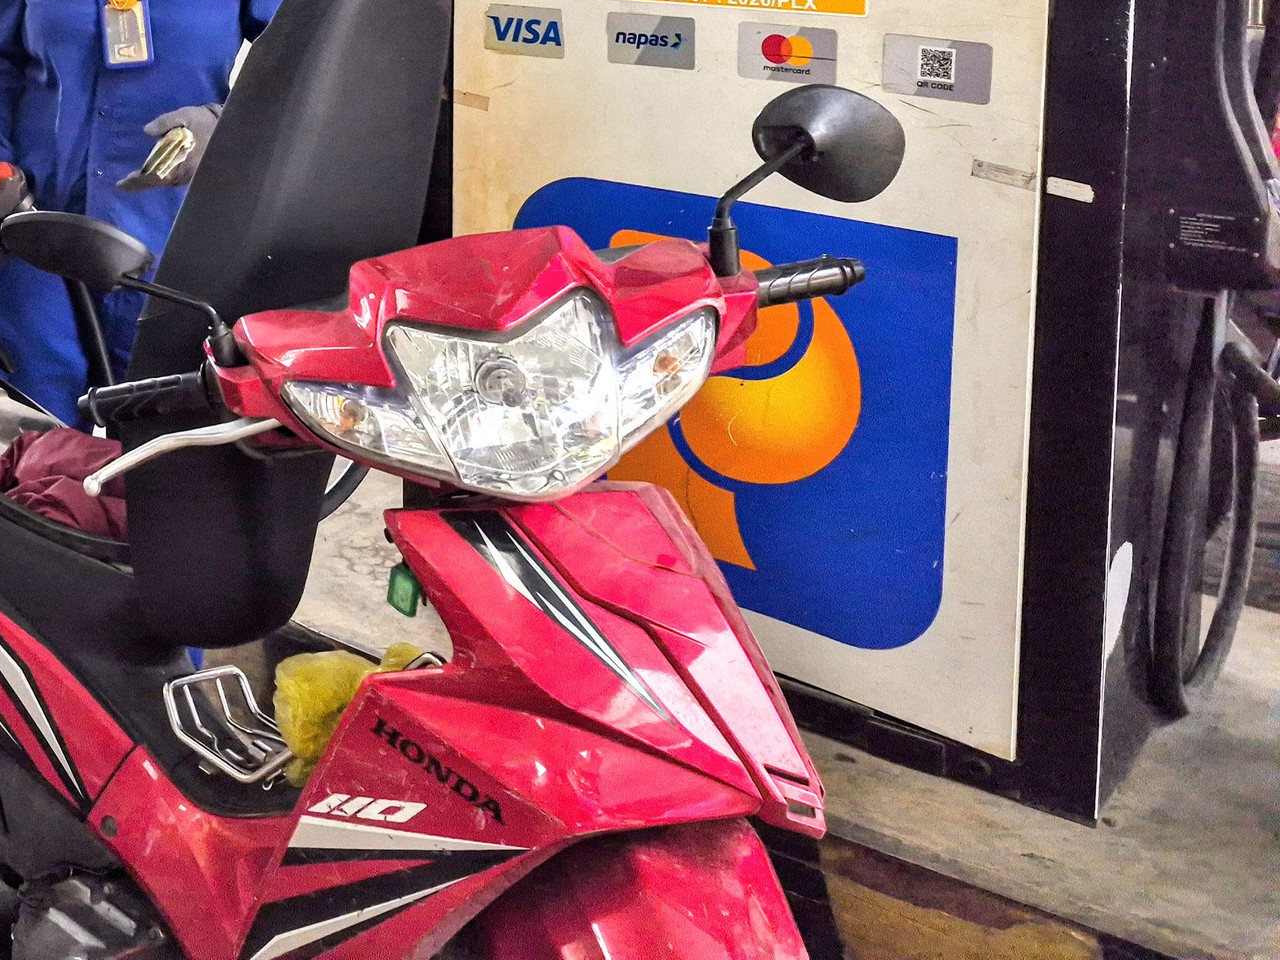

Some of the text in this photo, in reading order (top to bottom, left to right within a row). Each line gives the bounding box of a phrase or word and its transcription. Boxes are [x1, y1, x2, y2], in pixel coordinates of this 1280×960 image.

[487, 14, 562, 47] VISA
[616, 30, 669, 50] napas
[763, 64, 811, 75] mastercard
[917, 80, 954, 92] QR CODE
[372, 717, 505, 825] HONDA
